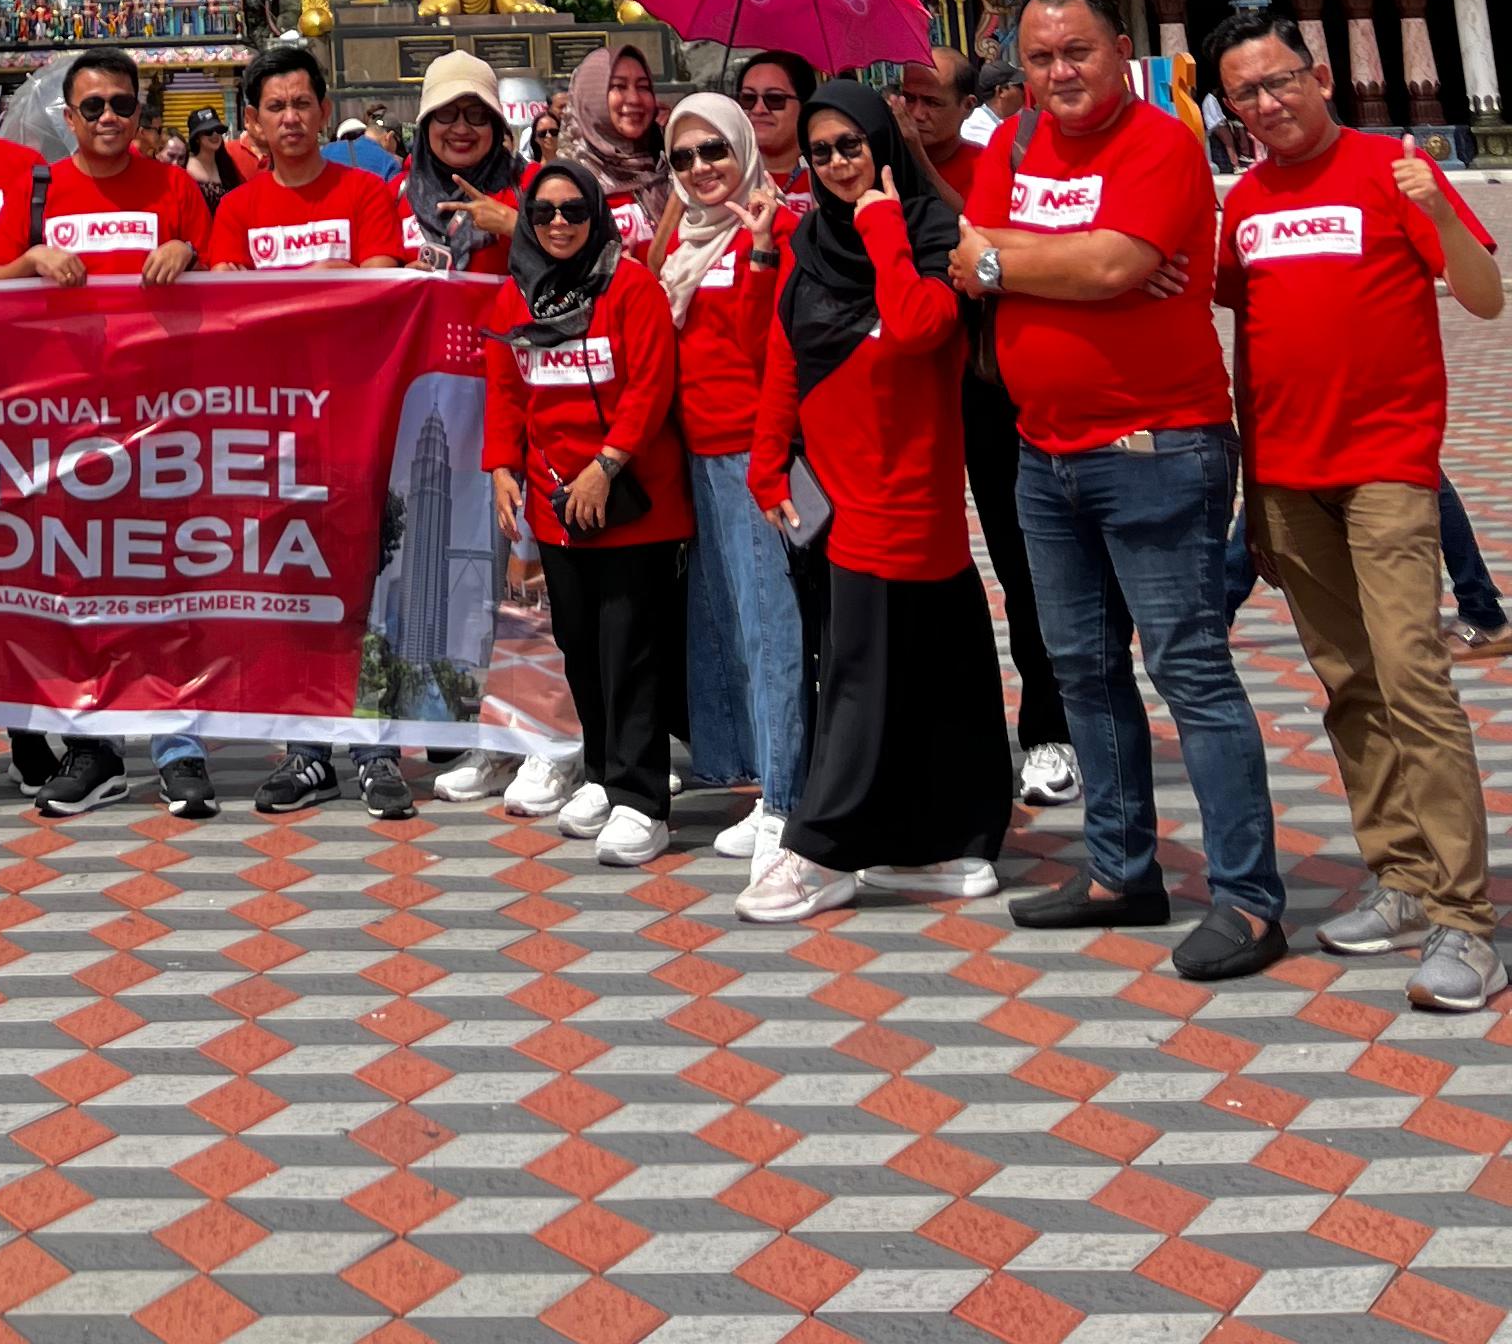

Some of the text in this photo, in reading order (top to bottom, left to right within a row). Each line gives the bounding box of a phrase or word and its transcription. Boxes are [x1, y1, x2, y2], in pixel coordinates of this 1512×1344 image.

[87, 219, 154, 237] NOBEL
[283, 228, 347, 250] NOBEL
[1271, 216, 1355, 240] NOBEL
[540, 348, 609, 368] NOBEL
[135, 385, 331, 421] MOBILITY
[75, 599, 130, 616] 22-26
[135, 594, 256, 615] SEPTEMBER
[261, 596, 311, 614] 2025
